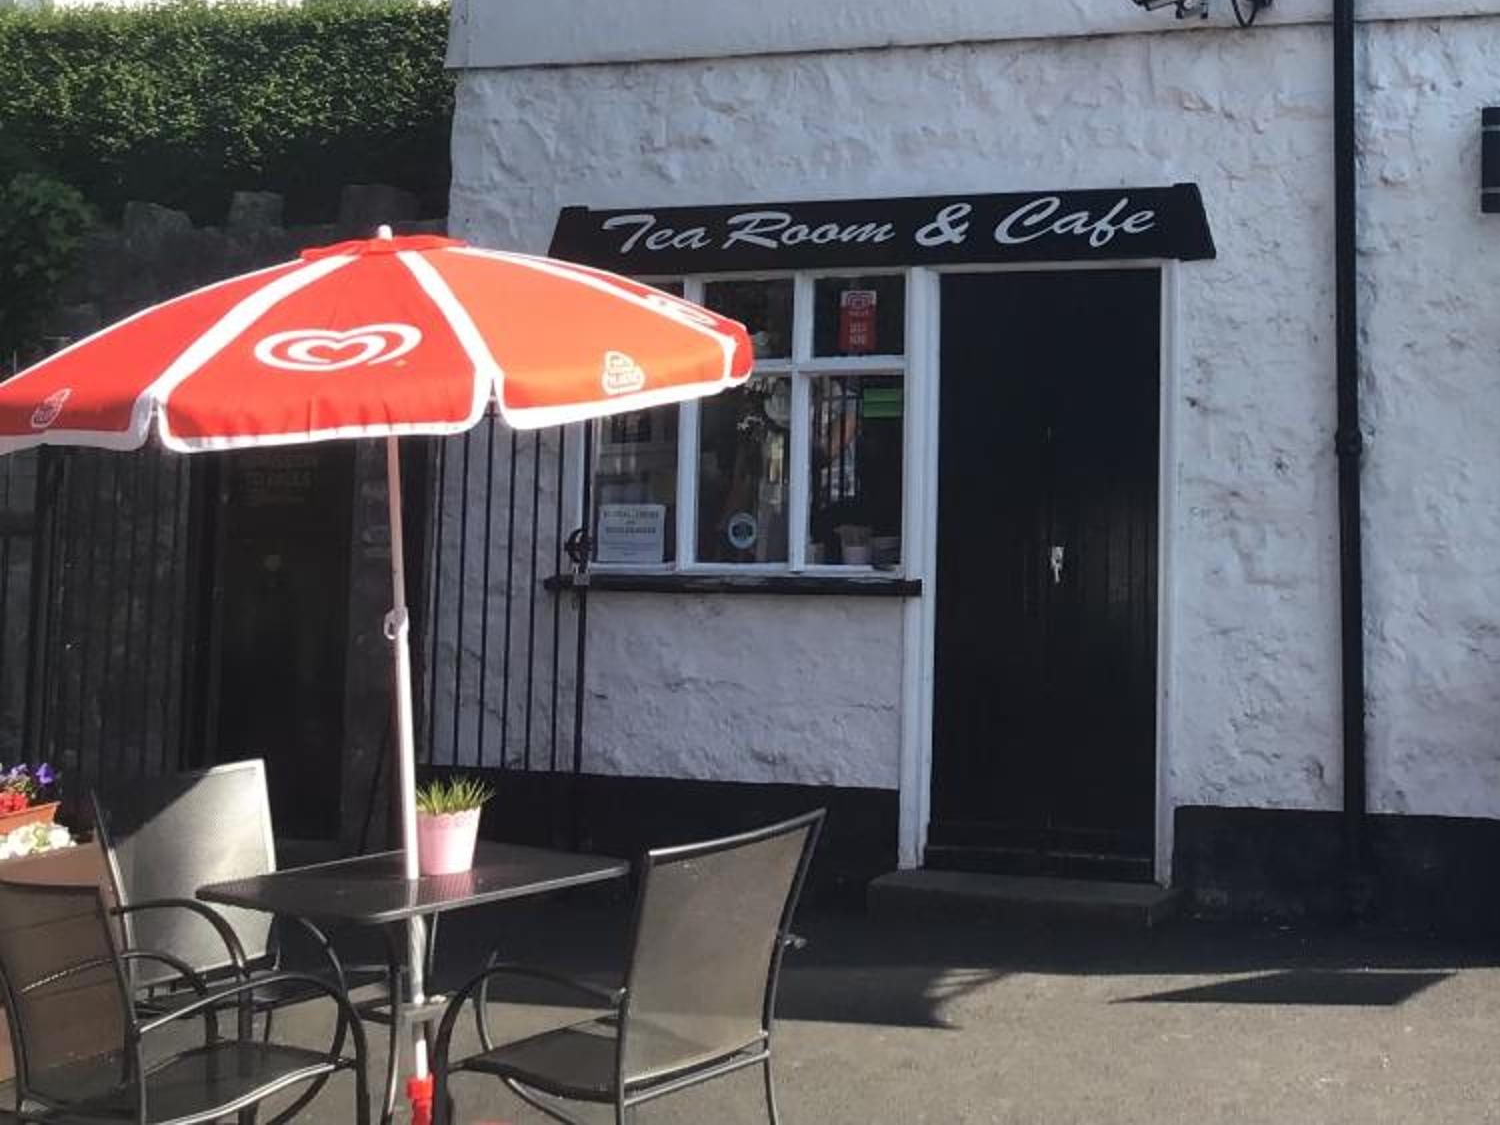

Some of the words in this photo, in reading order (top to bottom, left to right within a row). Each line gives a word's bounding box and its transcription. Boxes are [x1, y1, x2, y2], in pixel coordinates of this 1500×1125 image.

[602, 213, 708, 253] Tea
[720, 210, 896, 251] Room
[914, 203, 971, 247] &
[993, 195, 1157, 249] Cafe
